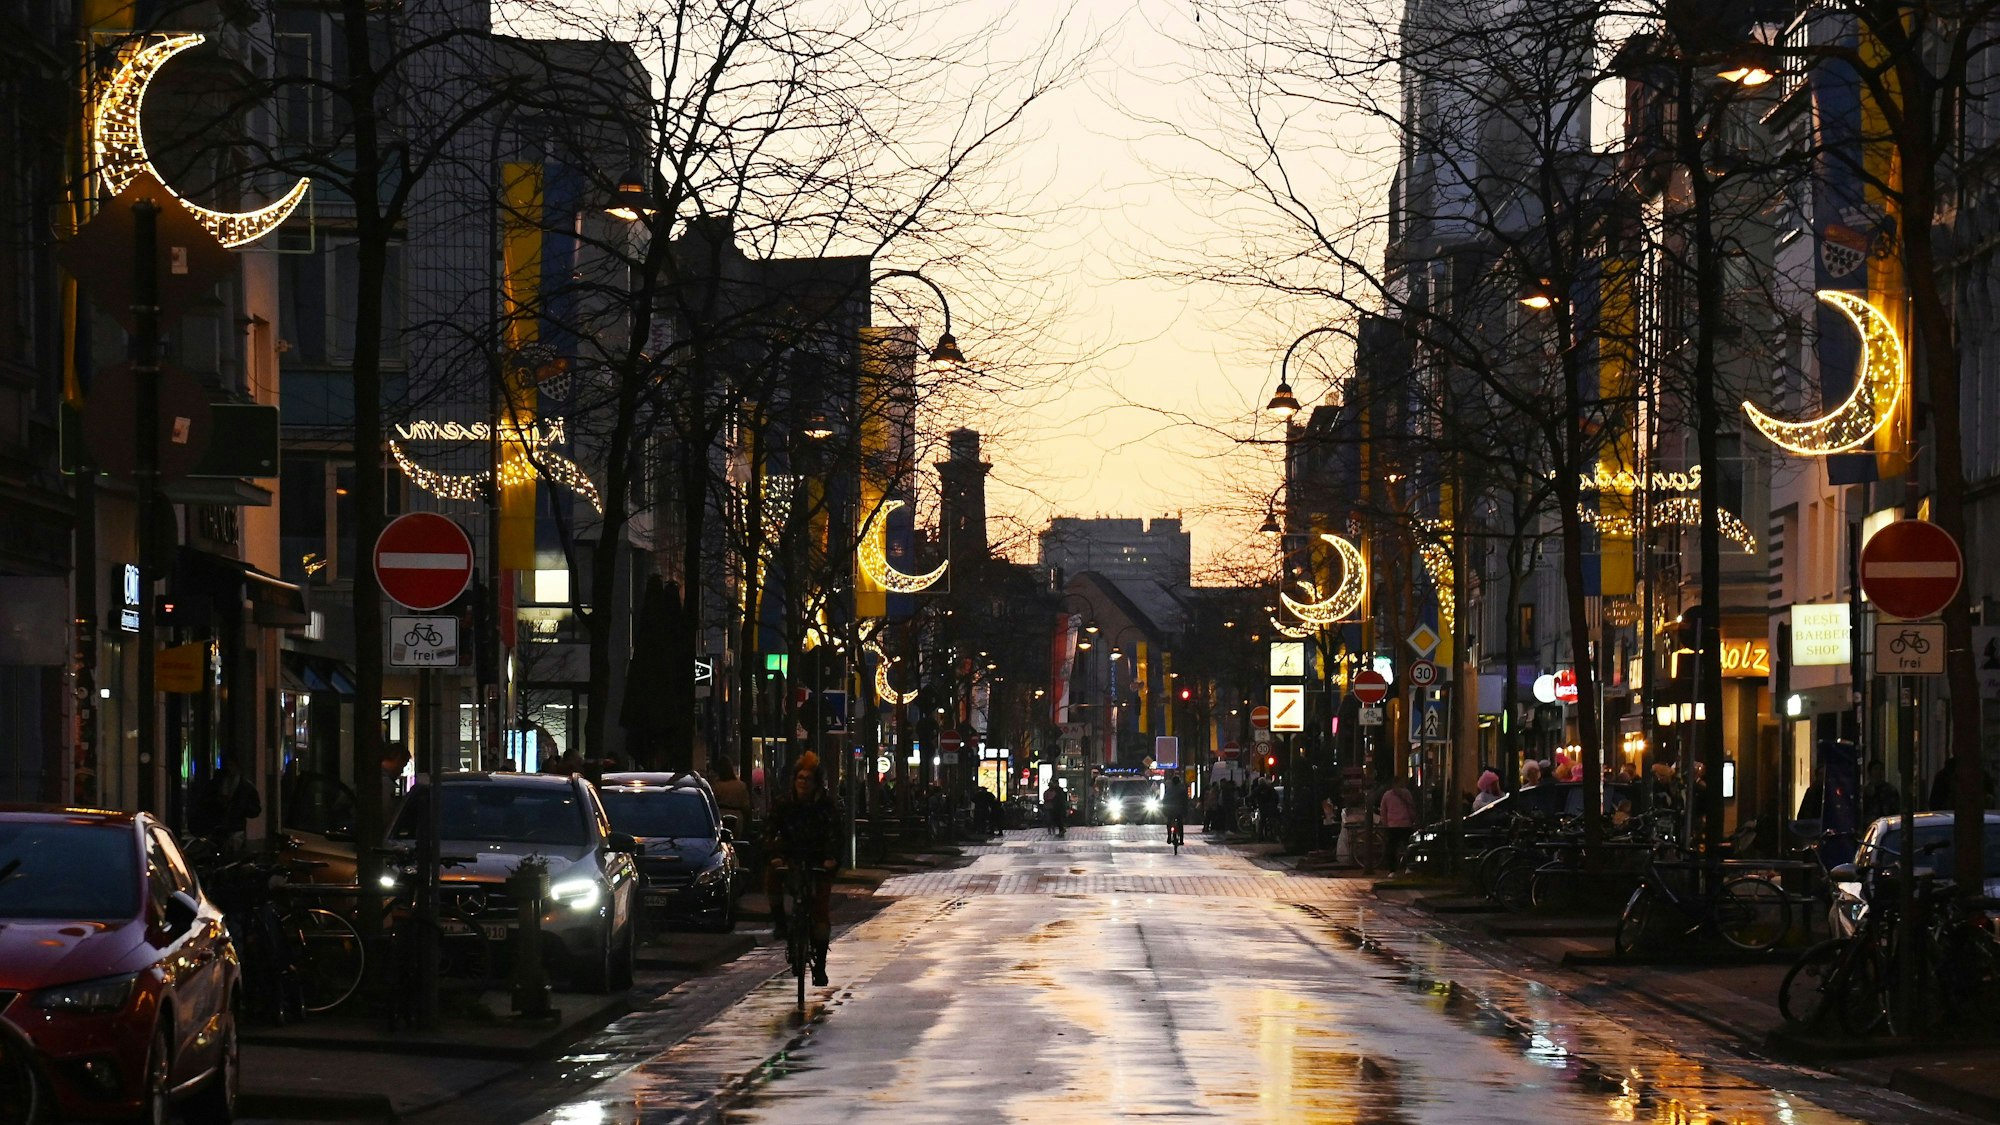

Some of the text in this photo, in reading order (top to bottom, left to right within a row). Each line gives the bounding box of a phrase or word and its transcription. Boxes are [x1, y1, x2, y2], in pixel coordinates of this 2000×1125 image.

[1795, 629, 1849, 641] BARBER
[413, 649, 434, 661] frei
[1806, 644, 1840, 656] SHOP
[1899, 657, 1921, 668] frei
[1415, 667, 1431, 679] 30
[1259, 745, 1268, 753] 30
